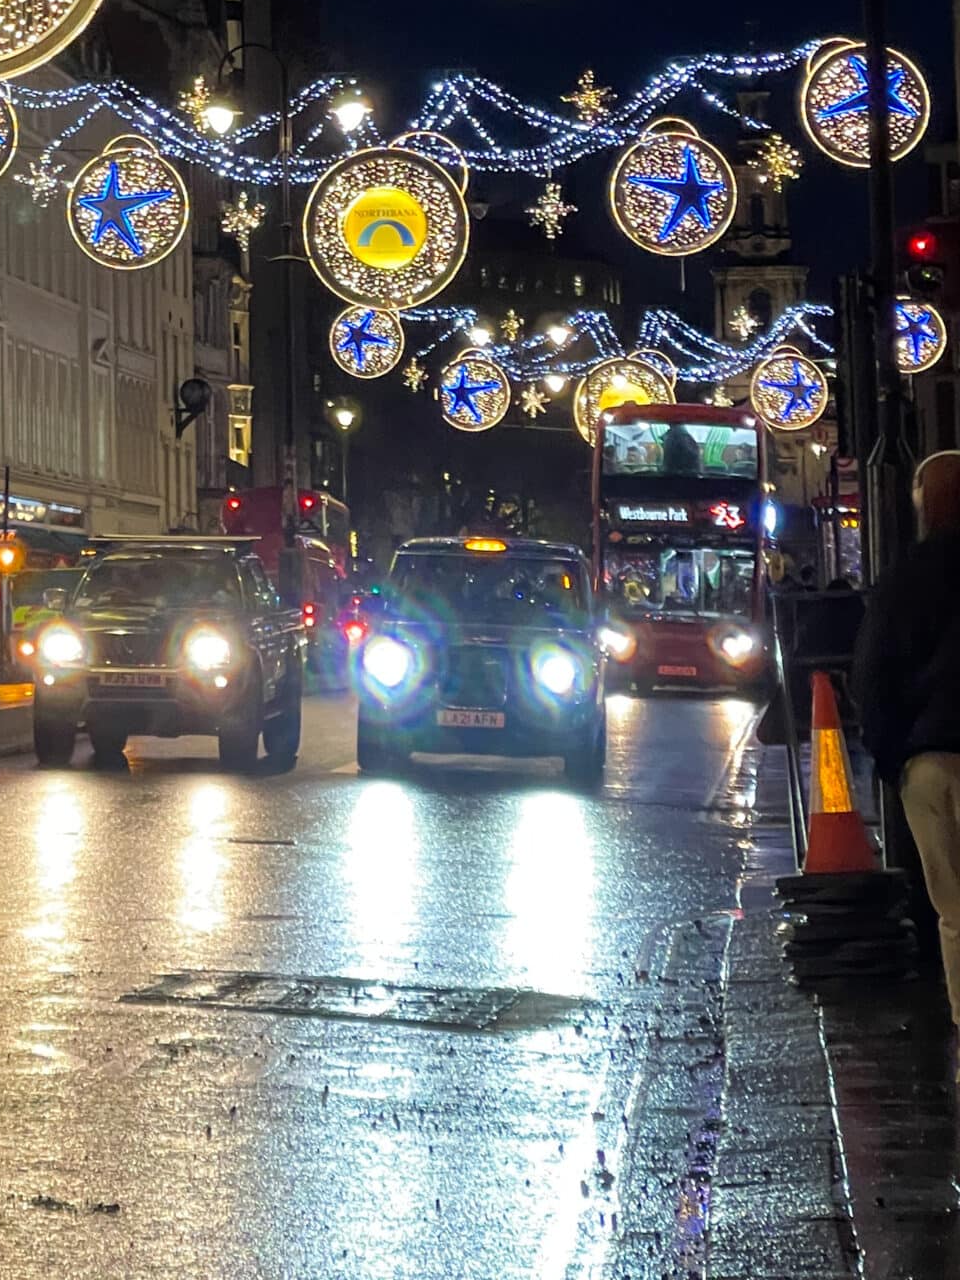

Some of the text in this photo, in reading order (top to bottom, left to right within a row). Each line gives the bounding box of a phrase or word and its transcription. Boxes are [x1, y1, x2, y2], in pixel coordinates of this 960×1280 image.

[354, 208, 418, 218] NORTHBANK
[620, 506, 667, 520] Westbourne
[668, 507, 688, 521] Park
